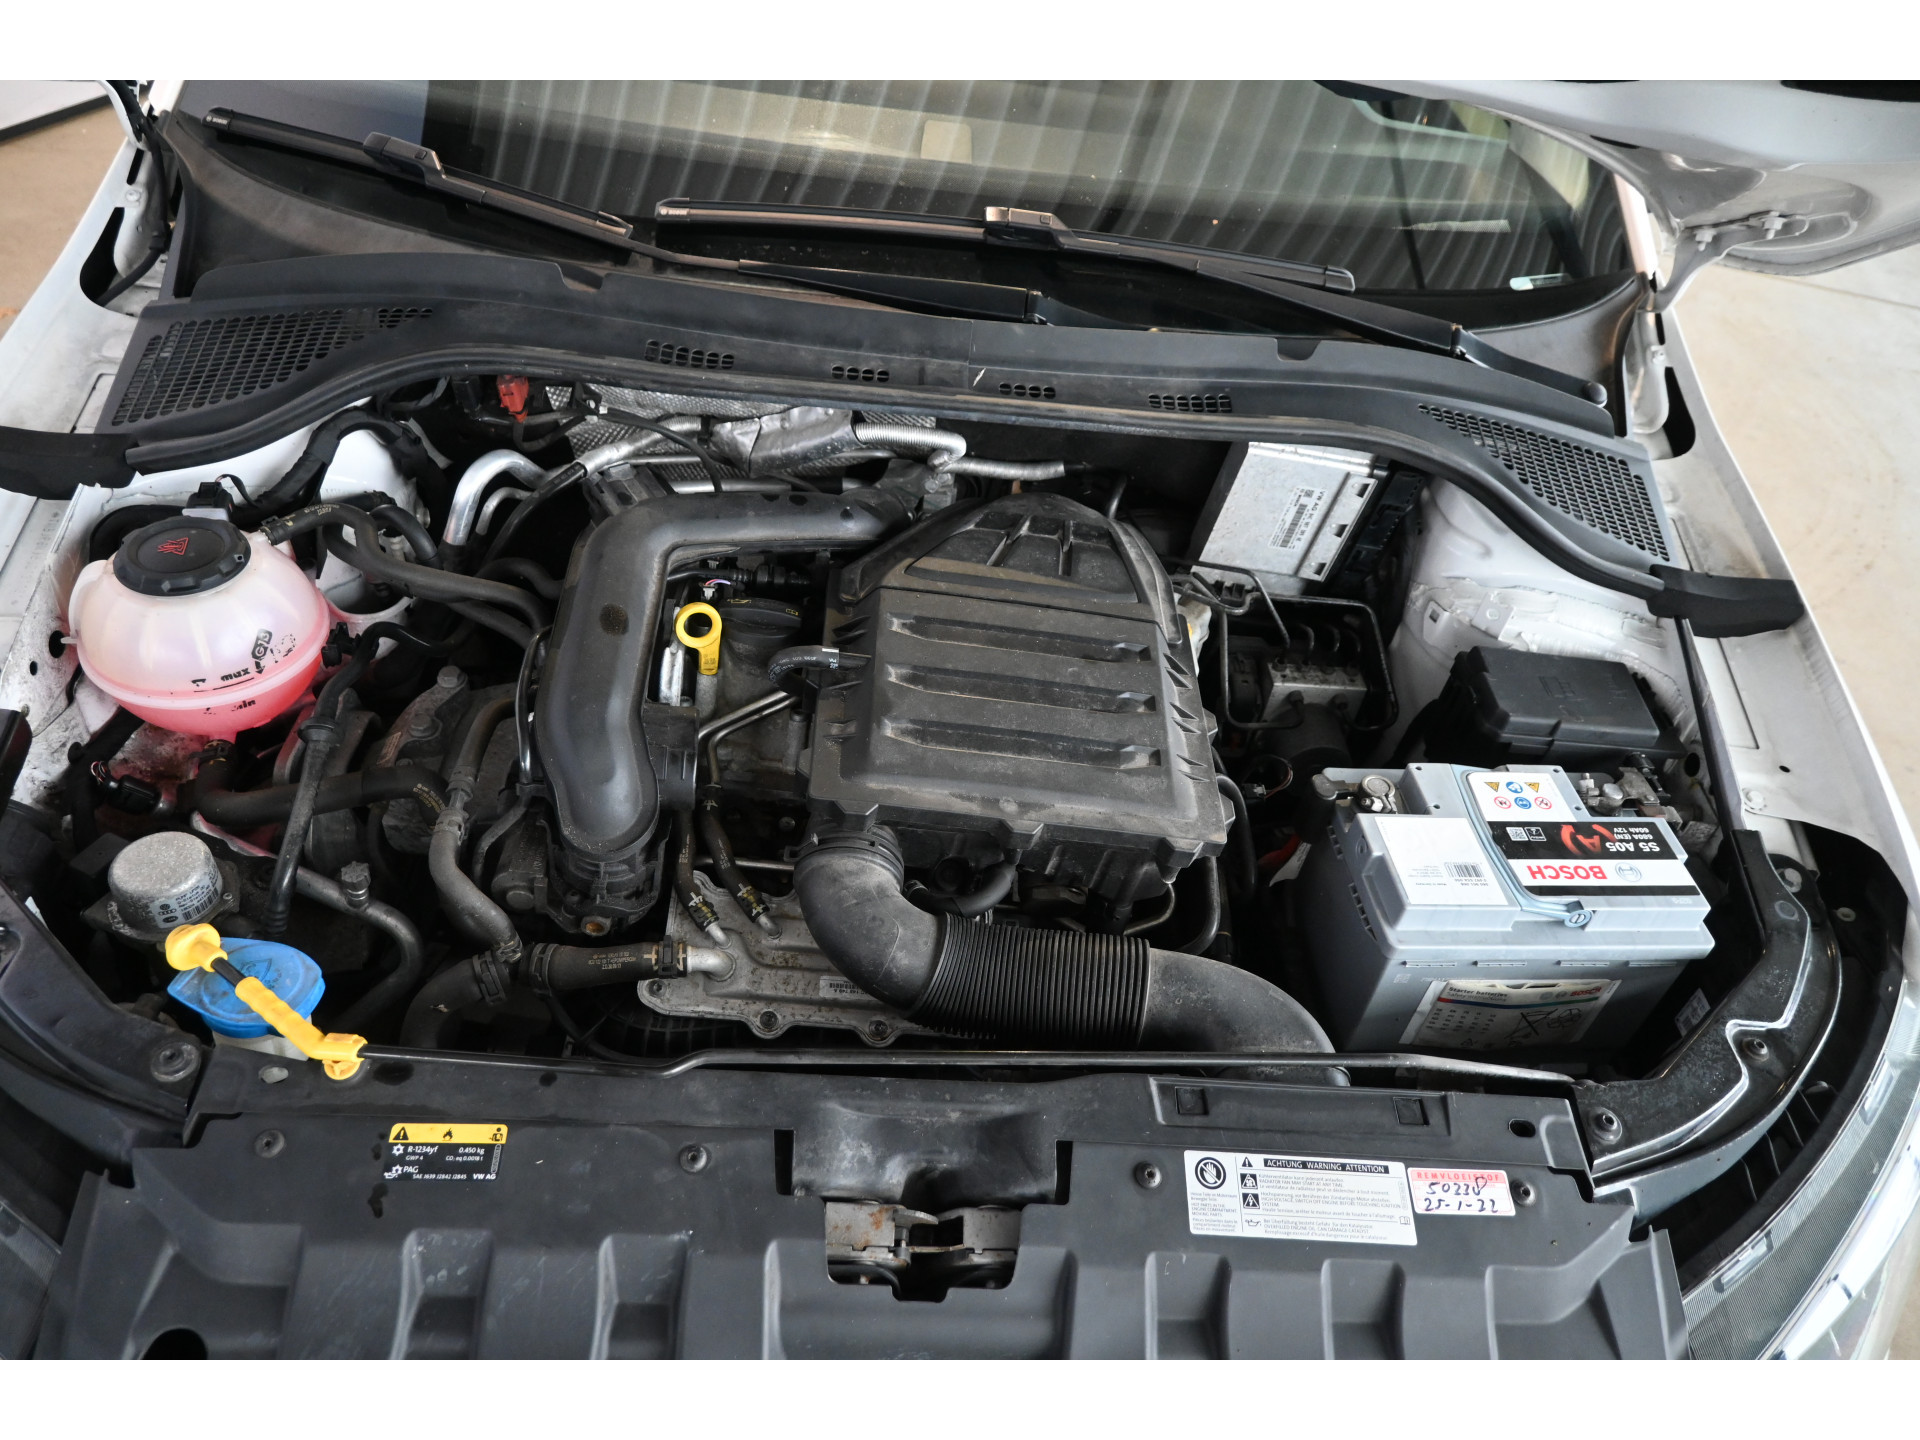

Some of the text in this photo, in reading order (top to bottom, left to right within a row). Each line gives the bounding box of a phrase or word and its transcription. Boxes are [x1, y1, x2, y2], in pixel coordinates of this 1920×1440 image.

[1605, 841, 1660, 852] S5 A05
[1527, 865, 1608, 880] BOSCH
[1449, 986, 1508, 998] Starter batteries
[1570, 986, 1602, 997] BOSCH
[408, 1145, 439, 1154] R-1234yf
[477, 1147, 485, 1155] kg
[1267, 1160, 1384, 1173] ACHTUNG WARNING ATTENTION
[1417, 1172, 1499, 1181] REMVLOEISTOF
